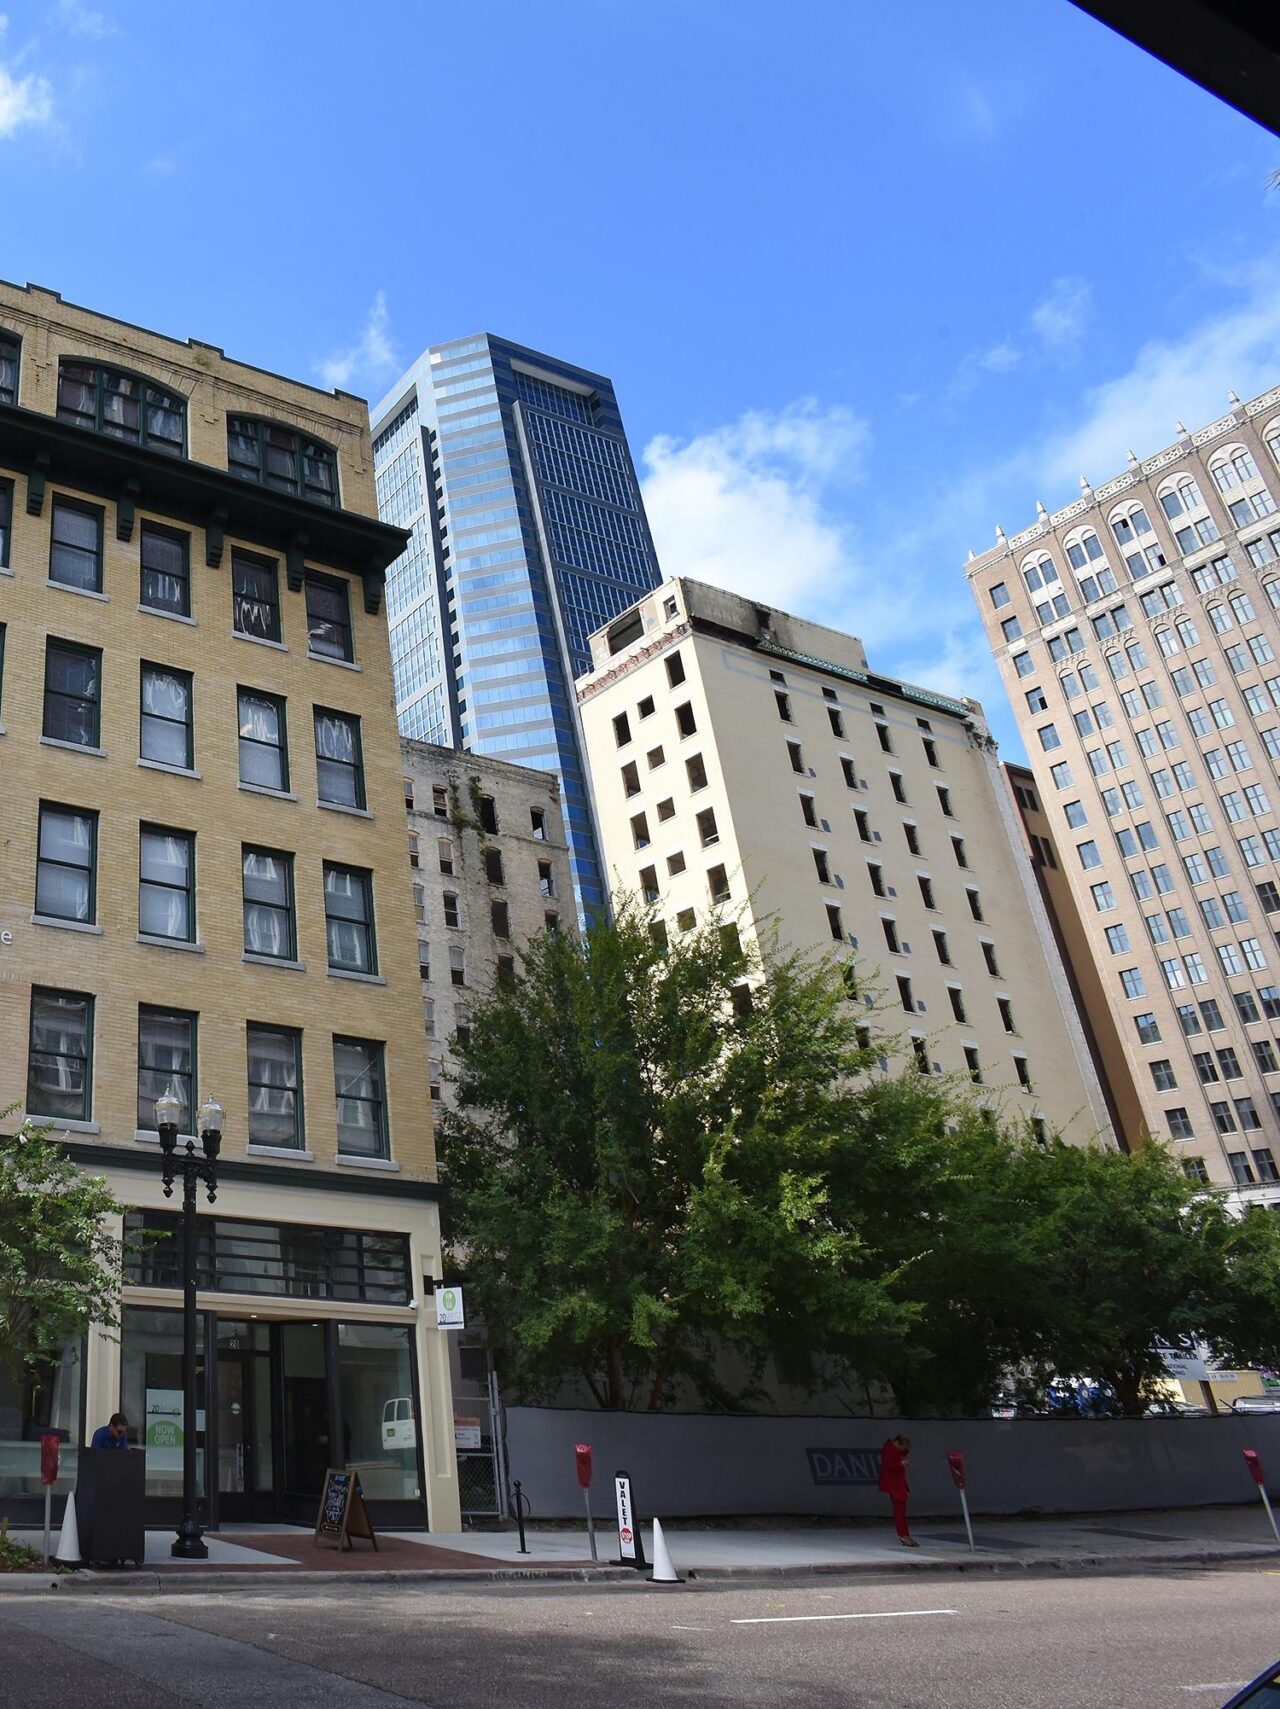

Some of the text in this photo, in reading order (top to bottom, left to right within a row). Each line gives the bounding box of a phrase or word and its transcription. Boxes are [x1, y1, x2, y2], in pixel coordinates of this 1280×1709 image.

[156, 1424, 175, 1434] NOW
[155, 1435, 176, 1445] OPEN
[811, 1453, 882, 1477] DANI
[619, 1481, 628, 1525] VALET
